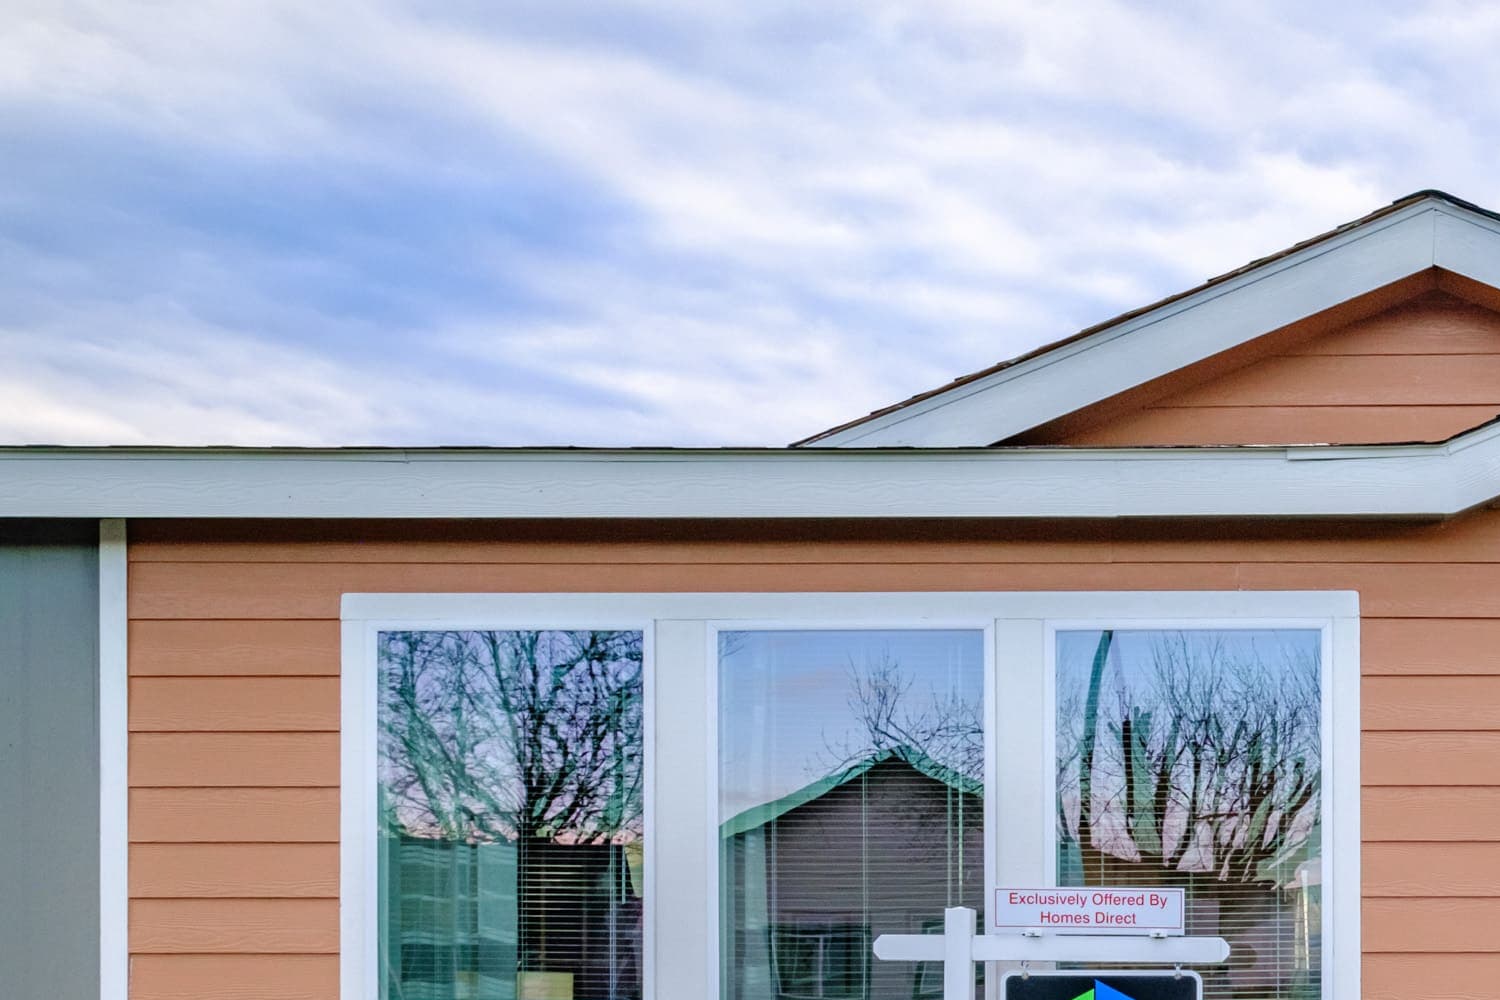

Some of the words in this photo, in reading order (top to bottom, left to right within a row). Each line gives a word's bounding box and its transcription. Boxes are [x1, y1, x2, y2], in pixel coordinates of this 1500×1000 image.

[1009, 892, 1088, 908] Exclusively
[1092, 893, 1145, 906] Offered
[1149, 894, 1167, 909] By
[1040, 912, 1090, 924] Homes
[1095, 911, 1137, 925] Direct
